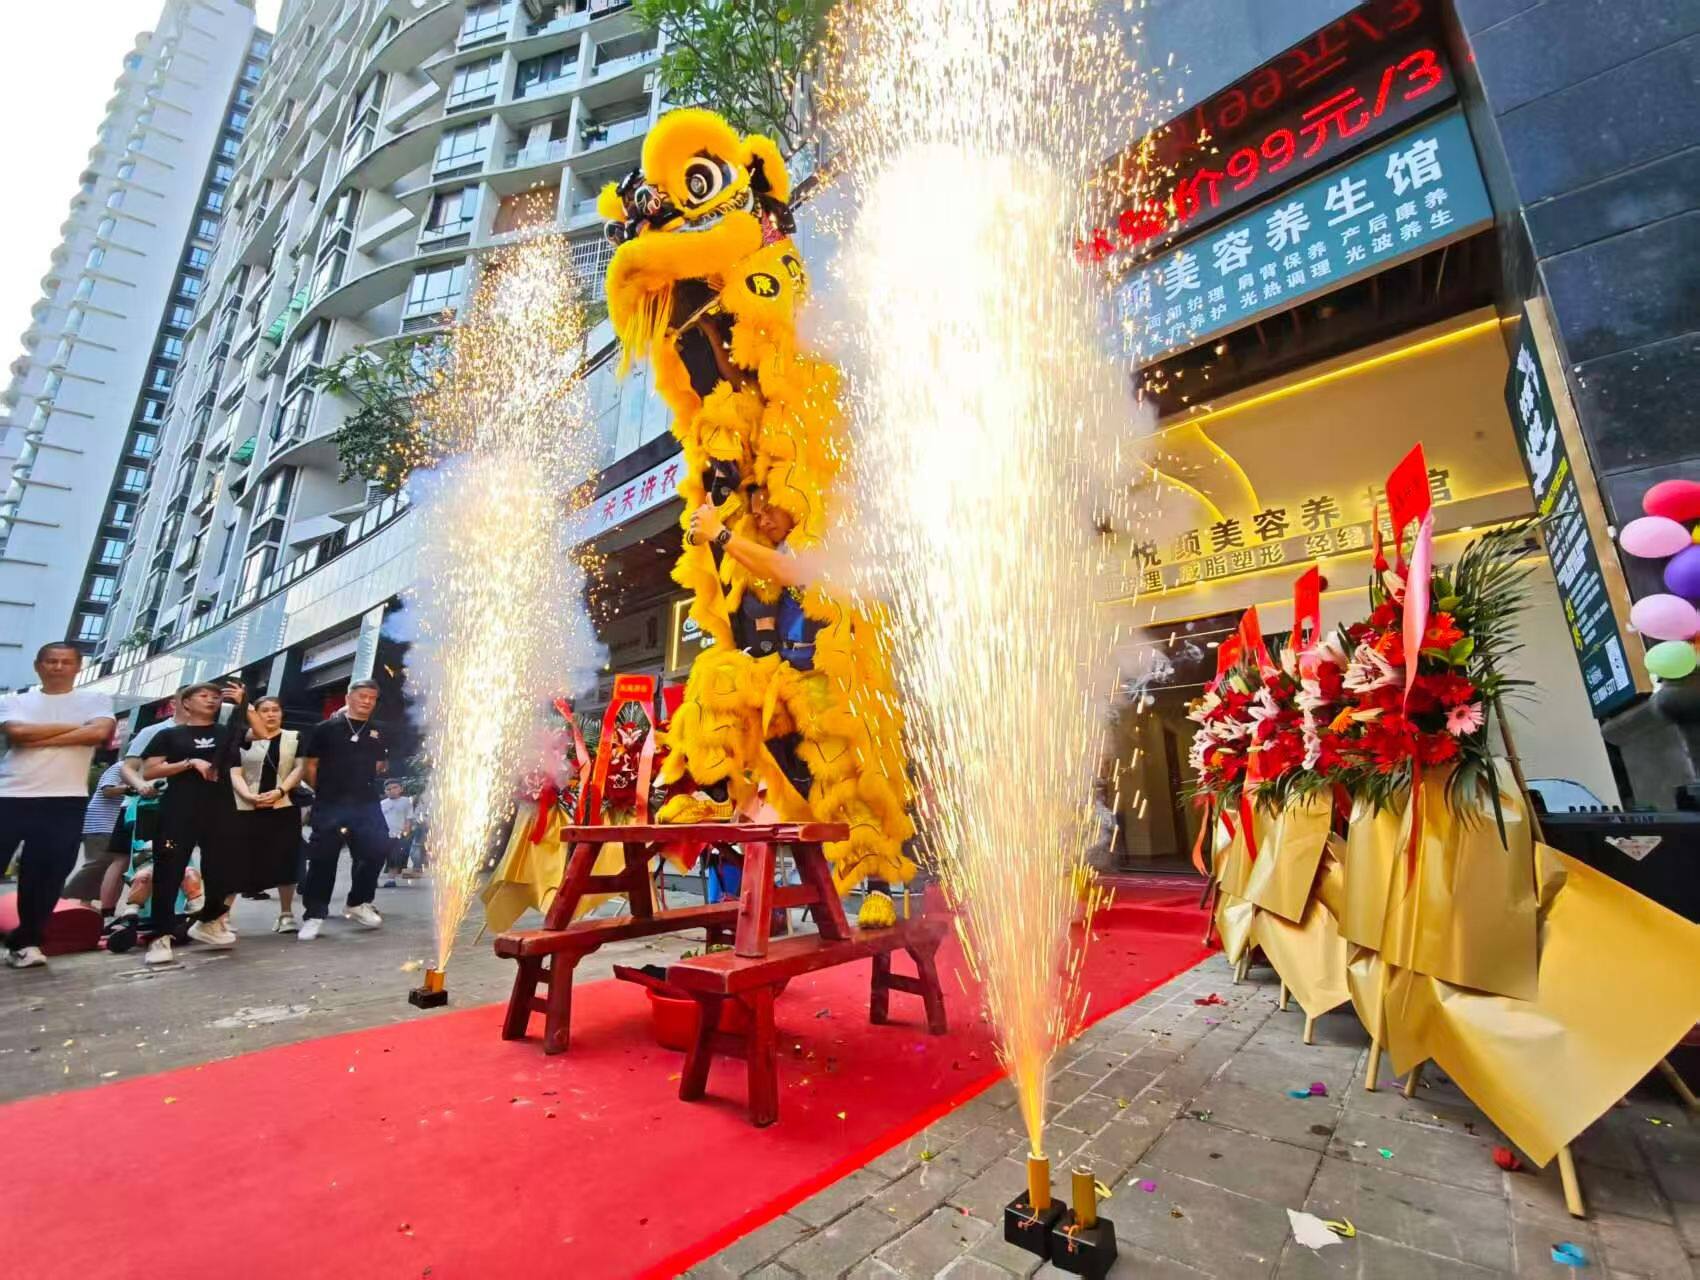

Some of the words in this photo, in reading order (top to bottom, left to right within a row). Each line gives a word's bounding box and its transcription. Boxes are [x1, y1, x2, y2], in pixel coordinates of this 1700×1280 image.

[1075, 48, 1443, 262] 价99元/3
[1238, 241, 1327, 292] 肩背保养
[1341, 188, 1448, 246] 产后康养
[1240, 259, 1331, 309] 光热调理
[1346, 209, 1454, 265] 光波养生
